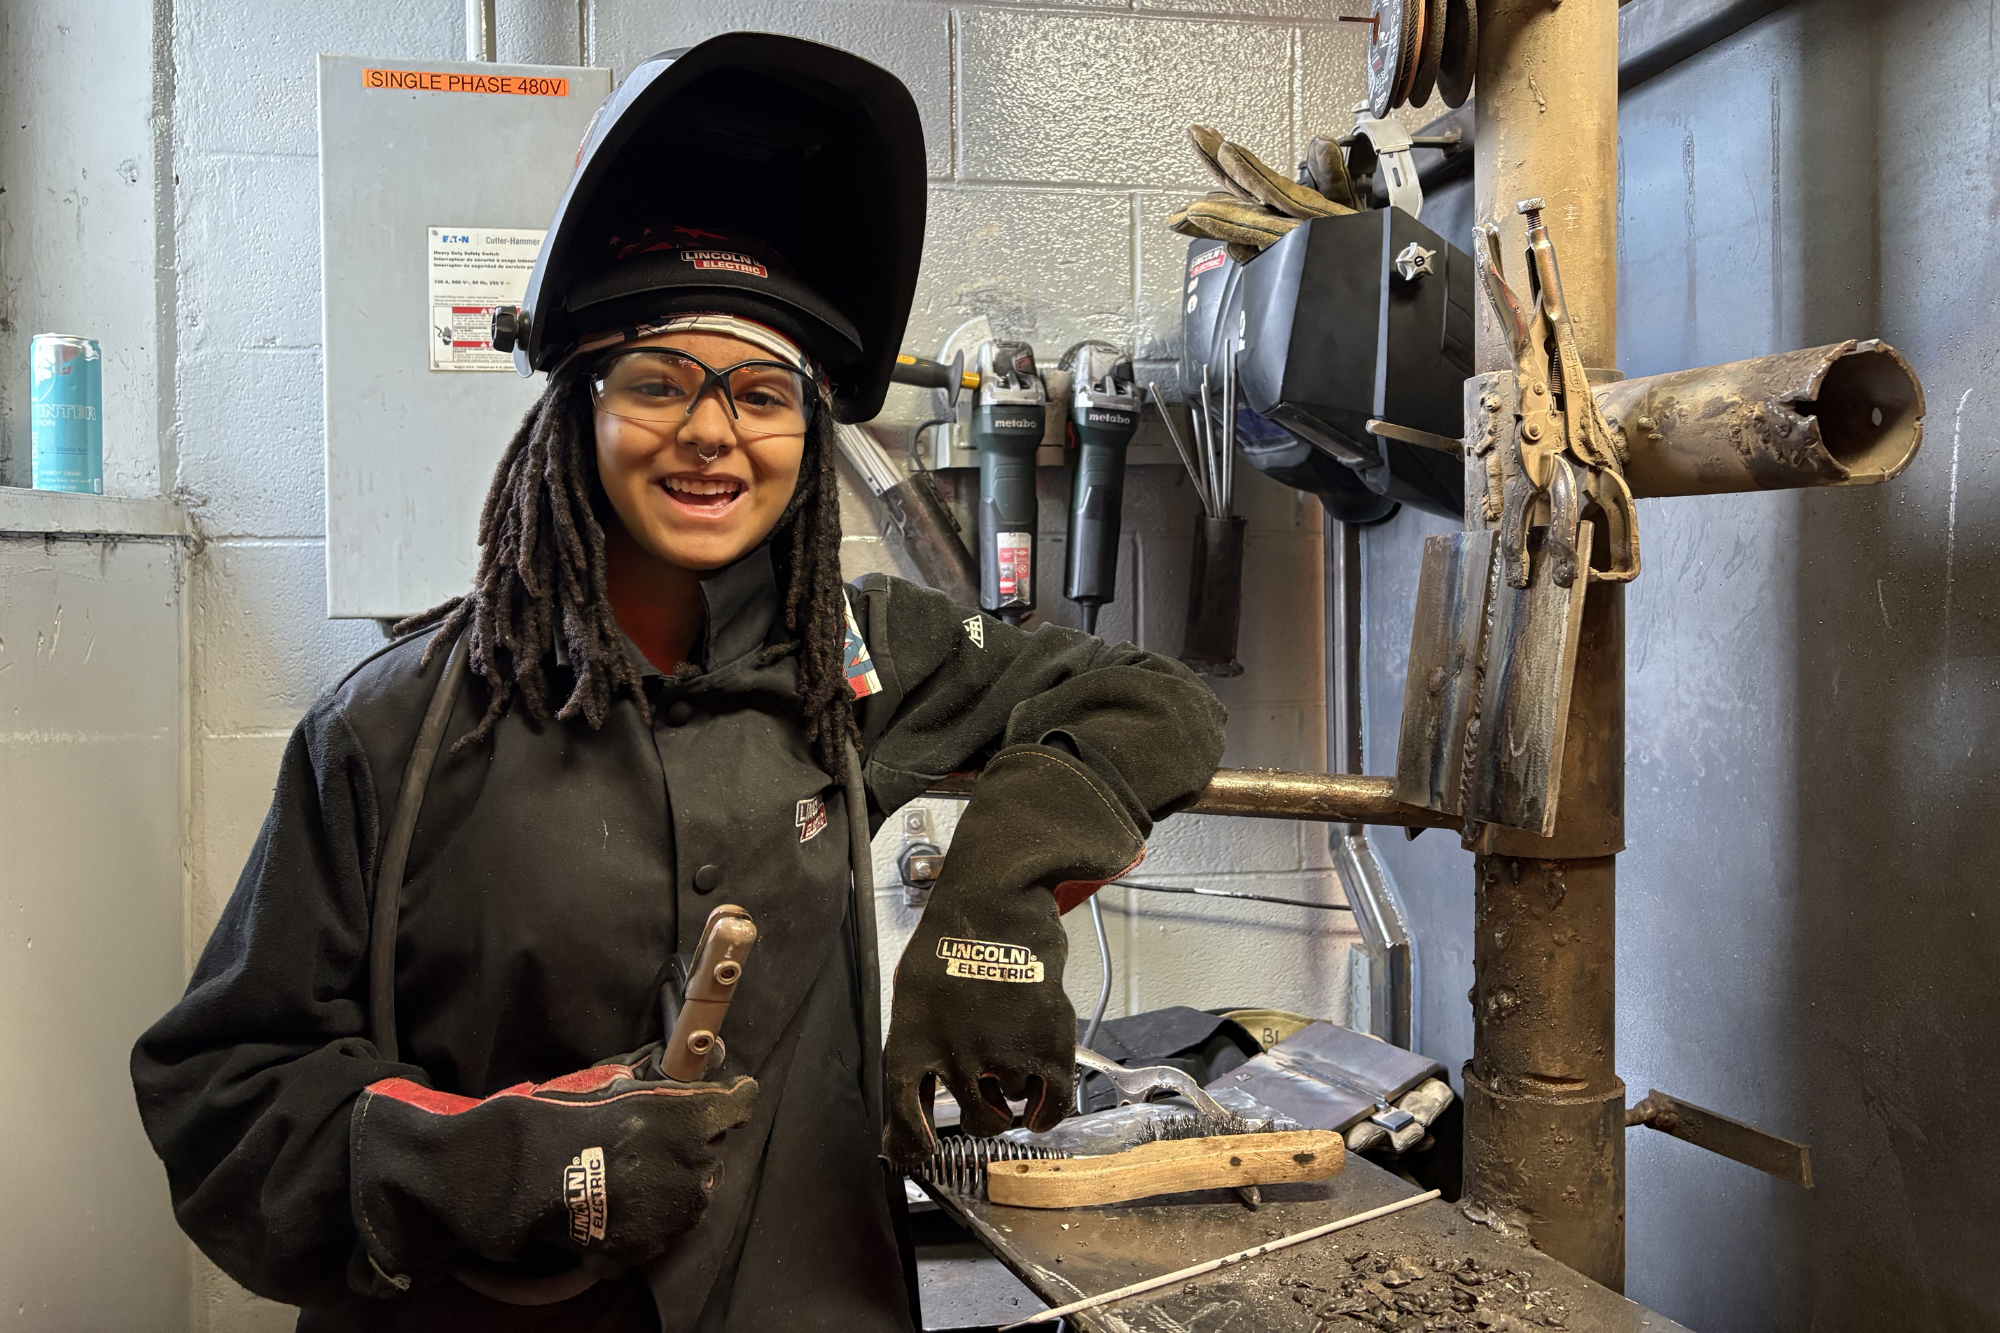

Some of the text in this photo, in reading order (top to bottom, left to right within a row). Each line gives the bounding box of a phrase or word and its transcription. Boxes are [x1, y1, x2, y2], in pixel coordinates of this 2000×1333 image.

[371, 71, 562, 95] SINGLE PHASE 480V
[486, 236, 540, 246] Cutler-Hammer
[685, 252, 752, 265] LINCOLN
[703, 260, 761, 274] ELECTRIC
[38, 403, 96, 420] INTER
[1088, 413, 1131, 425] metabo
[995, 419, 1037, 429] metabo
[942, 941, 1026, 965] LINCOLN
[958, 963, 1035, 979] ELECTRIC
[590, 1159, 605, 1230] ELECTRIC
[568, 1171, 589, 1241] LINCOLN
